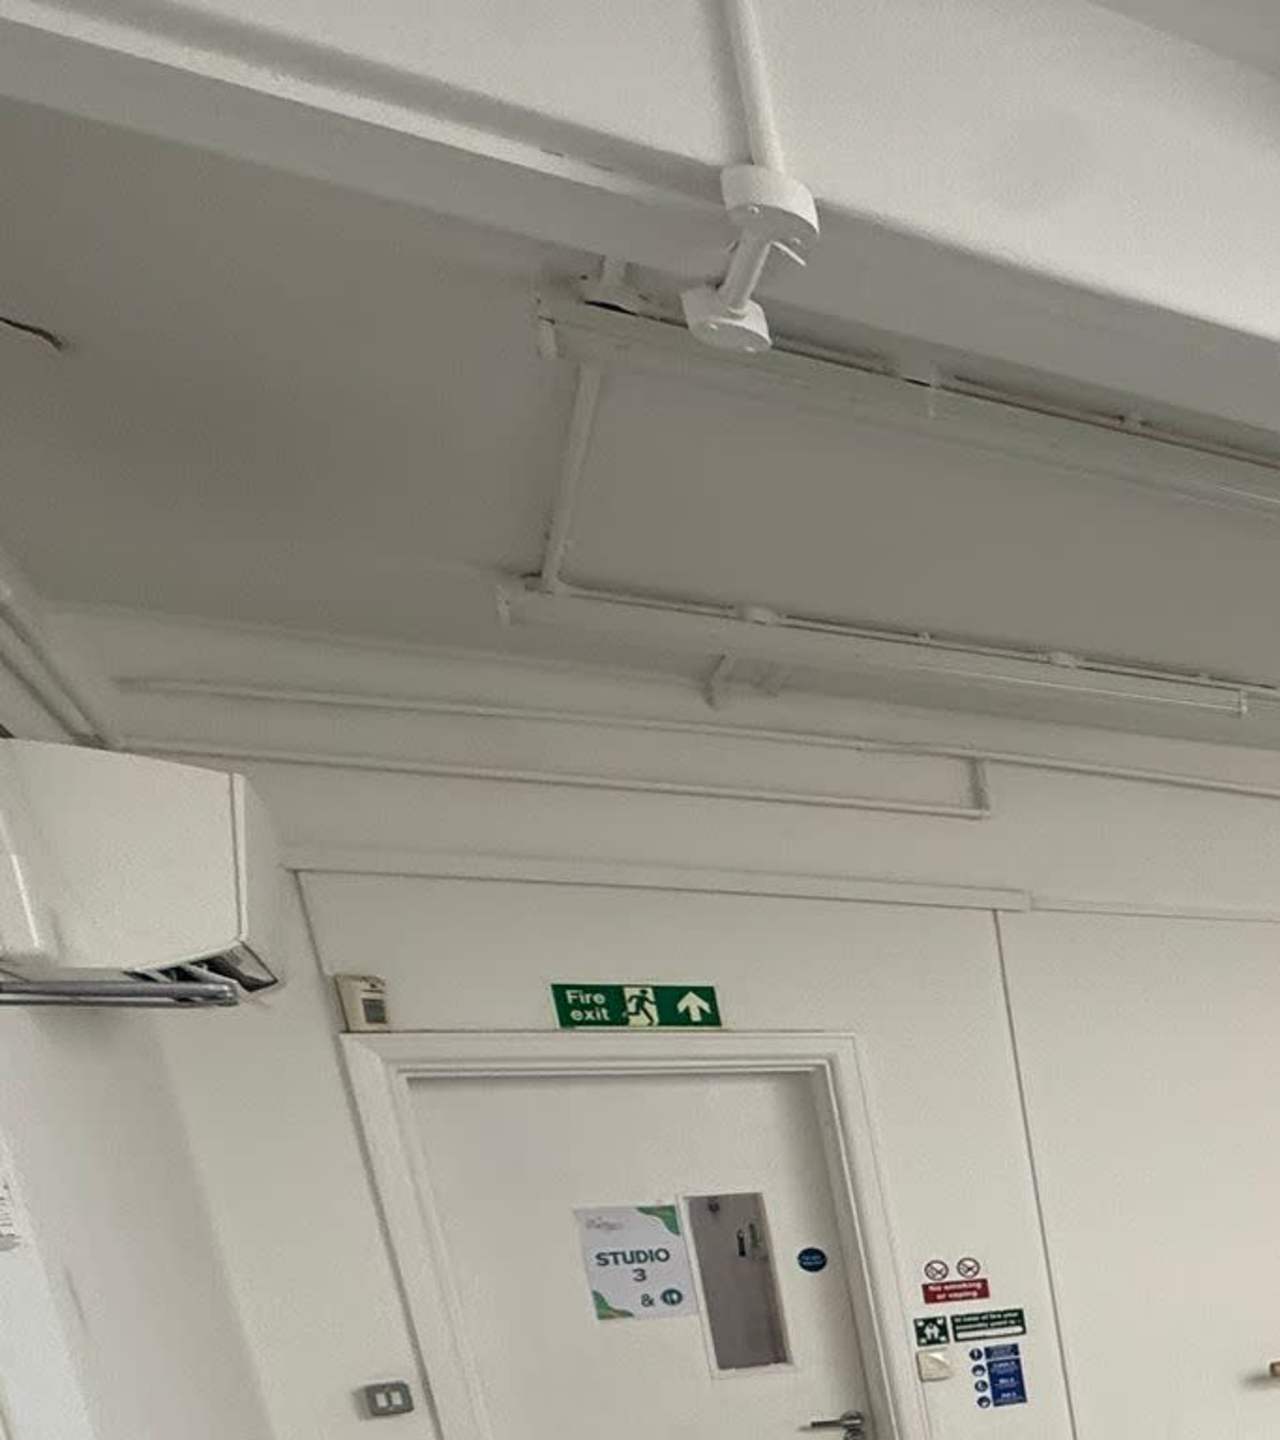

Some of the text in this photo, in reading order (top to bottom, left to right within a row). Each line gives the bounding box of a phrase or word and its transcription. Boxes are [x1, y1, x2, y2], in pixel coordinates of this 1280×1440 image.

[565, 989, 606, 1005] Fire
[570, 1007, 610, 1022] exit
[594, 1248, 671, 1267] STUDIO
[632, 1268, 647, 1283] 3
